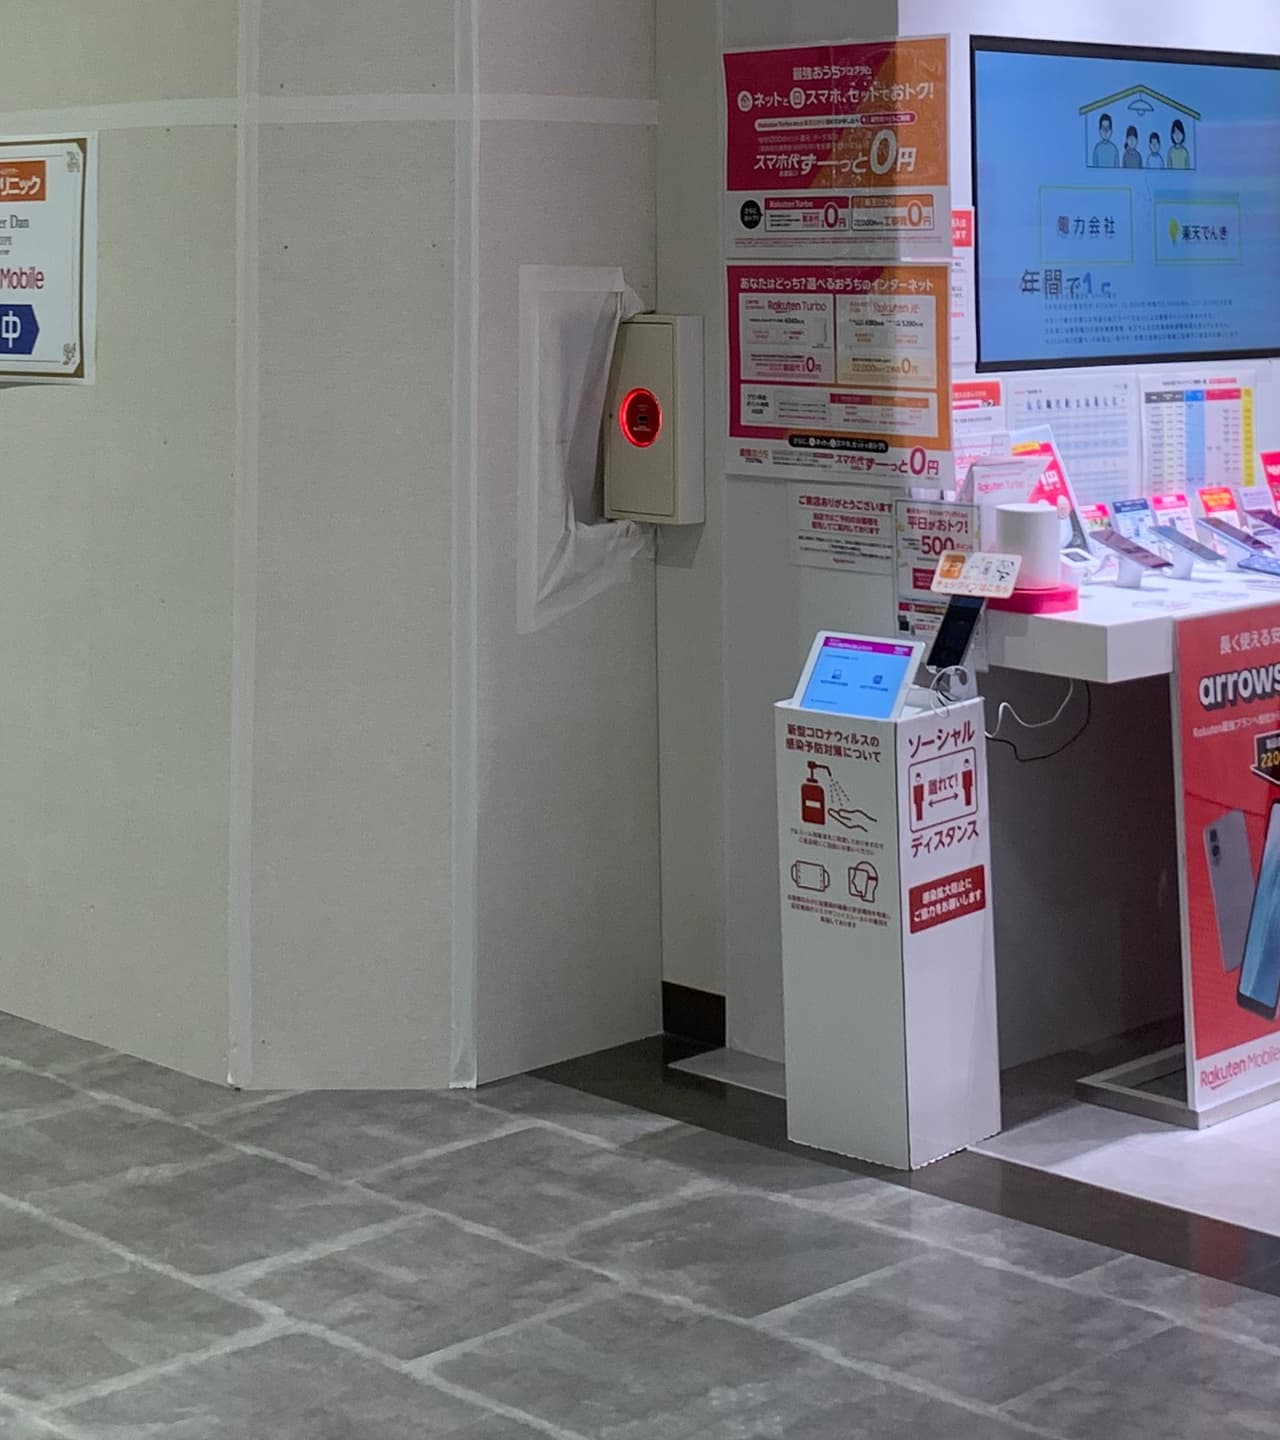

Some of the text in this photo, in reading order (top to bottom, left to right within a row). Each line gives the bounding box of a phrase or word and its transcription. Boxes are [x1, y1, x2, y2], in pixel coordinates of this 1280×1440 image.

[1057, 215, 1116, 237] 電力会社
[1181, 224, 1229, 241] 楽天でんき
[0, 267, 45, 289] Mobile
[907, 515, 969, 535] 平日がおトク!
[787, 723, 880, 747] 新型コロナウィルスの
[908, 720, 976, 758] ソーシャル
[785, 737, 882, 763] 感染予防対策について
[928, 772, 959, 796] 離れて!
[911, 820, 980, 859] ディスタンス
[1200, 1046, 1280, 1090] Rakuten Mobile
